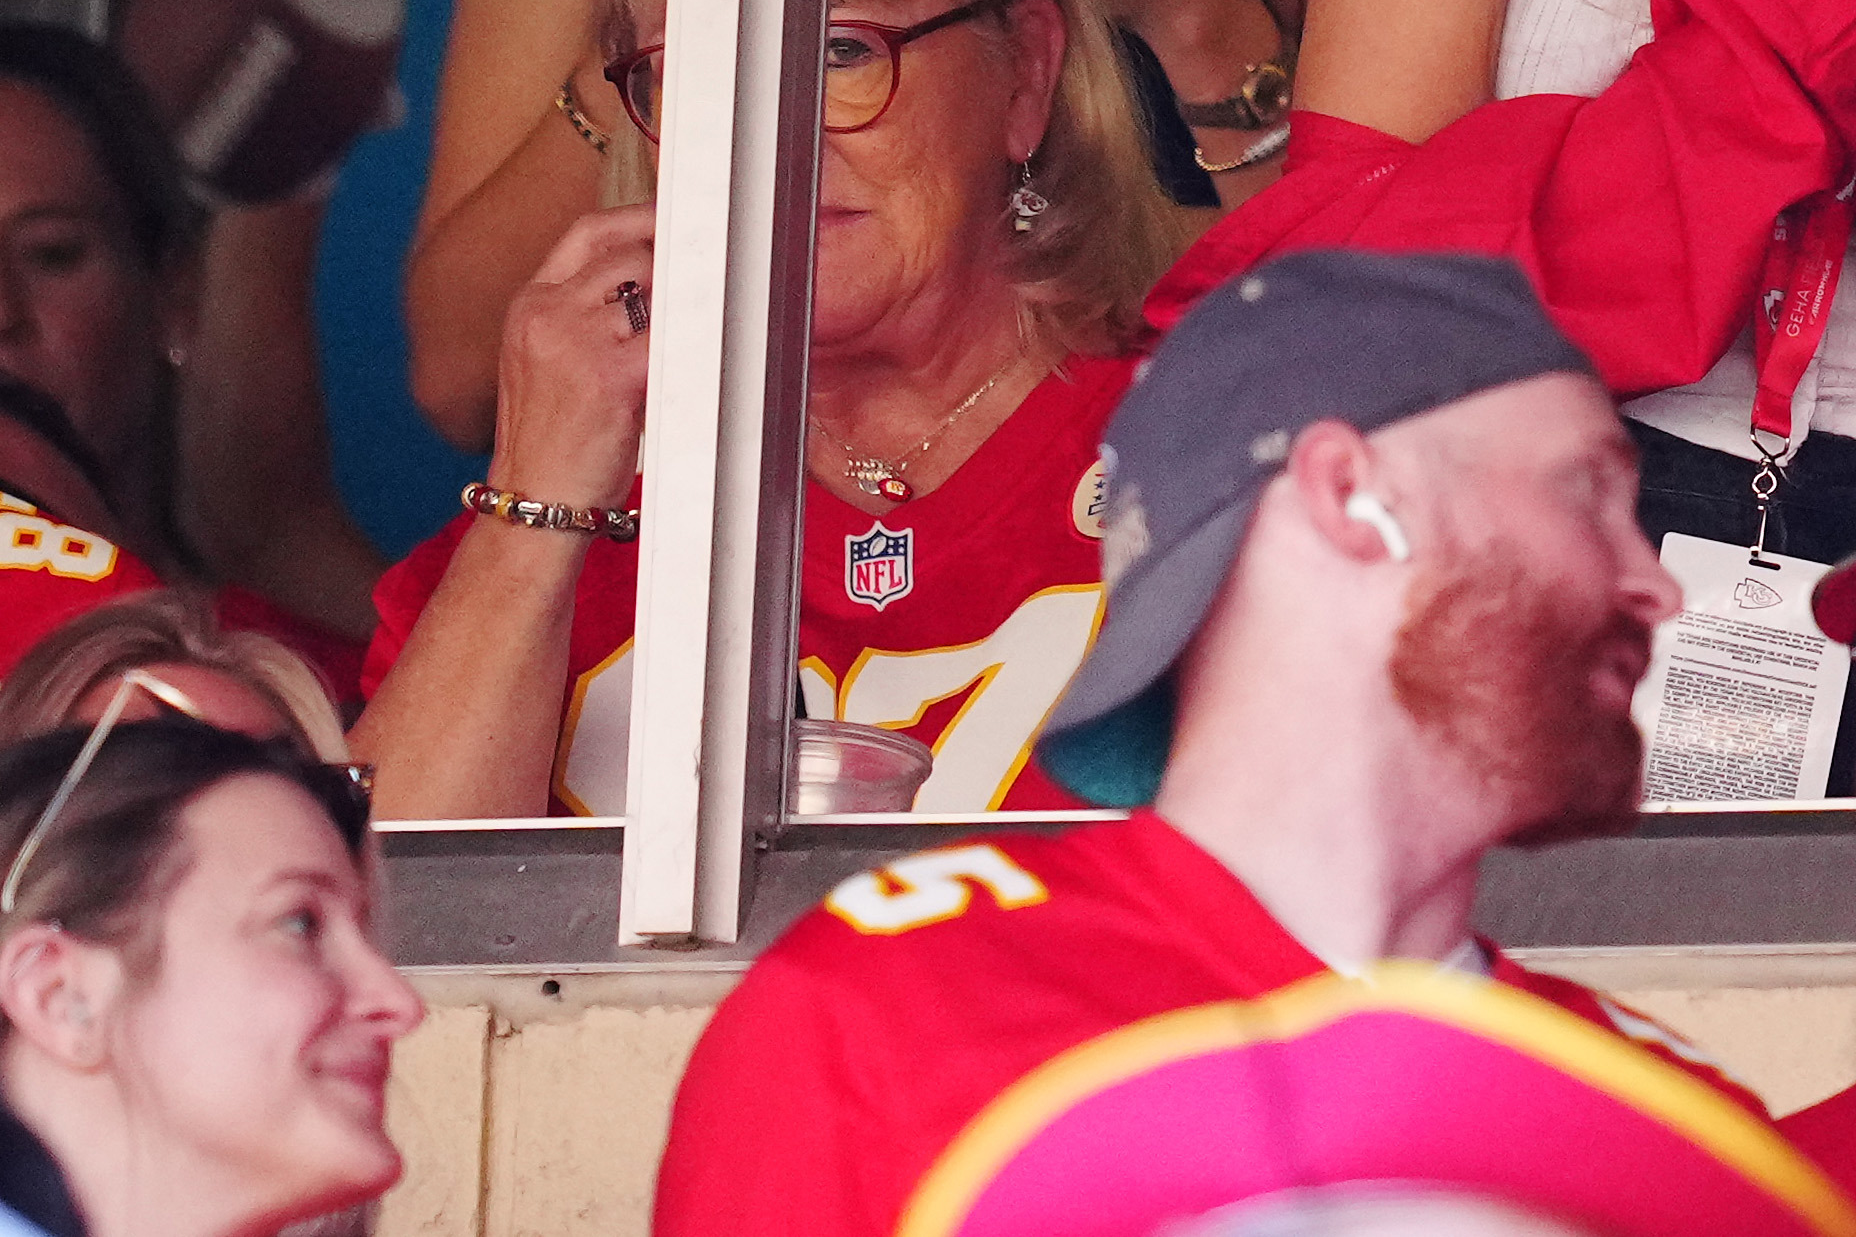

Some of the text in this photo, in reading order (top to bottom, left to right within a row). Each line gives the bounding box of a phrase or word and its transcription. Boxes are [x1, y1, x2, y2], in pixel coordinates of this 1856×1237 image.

[1786, 289, 1811, 337] GEHA
[856, 559, 903, 594] NFL
[824, 843, 1050, 934] 5
